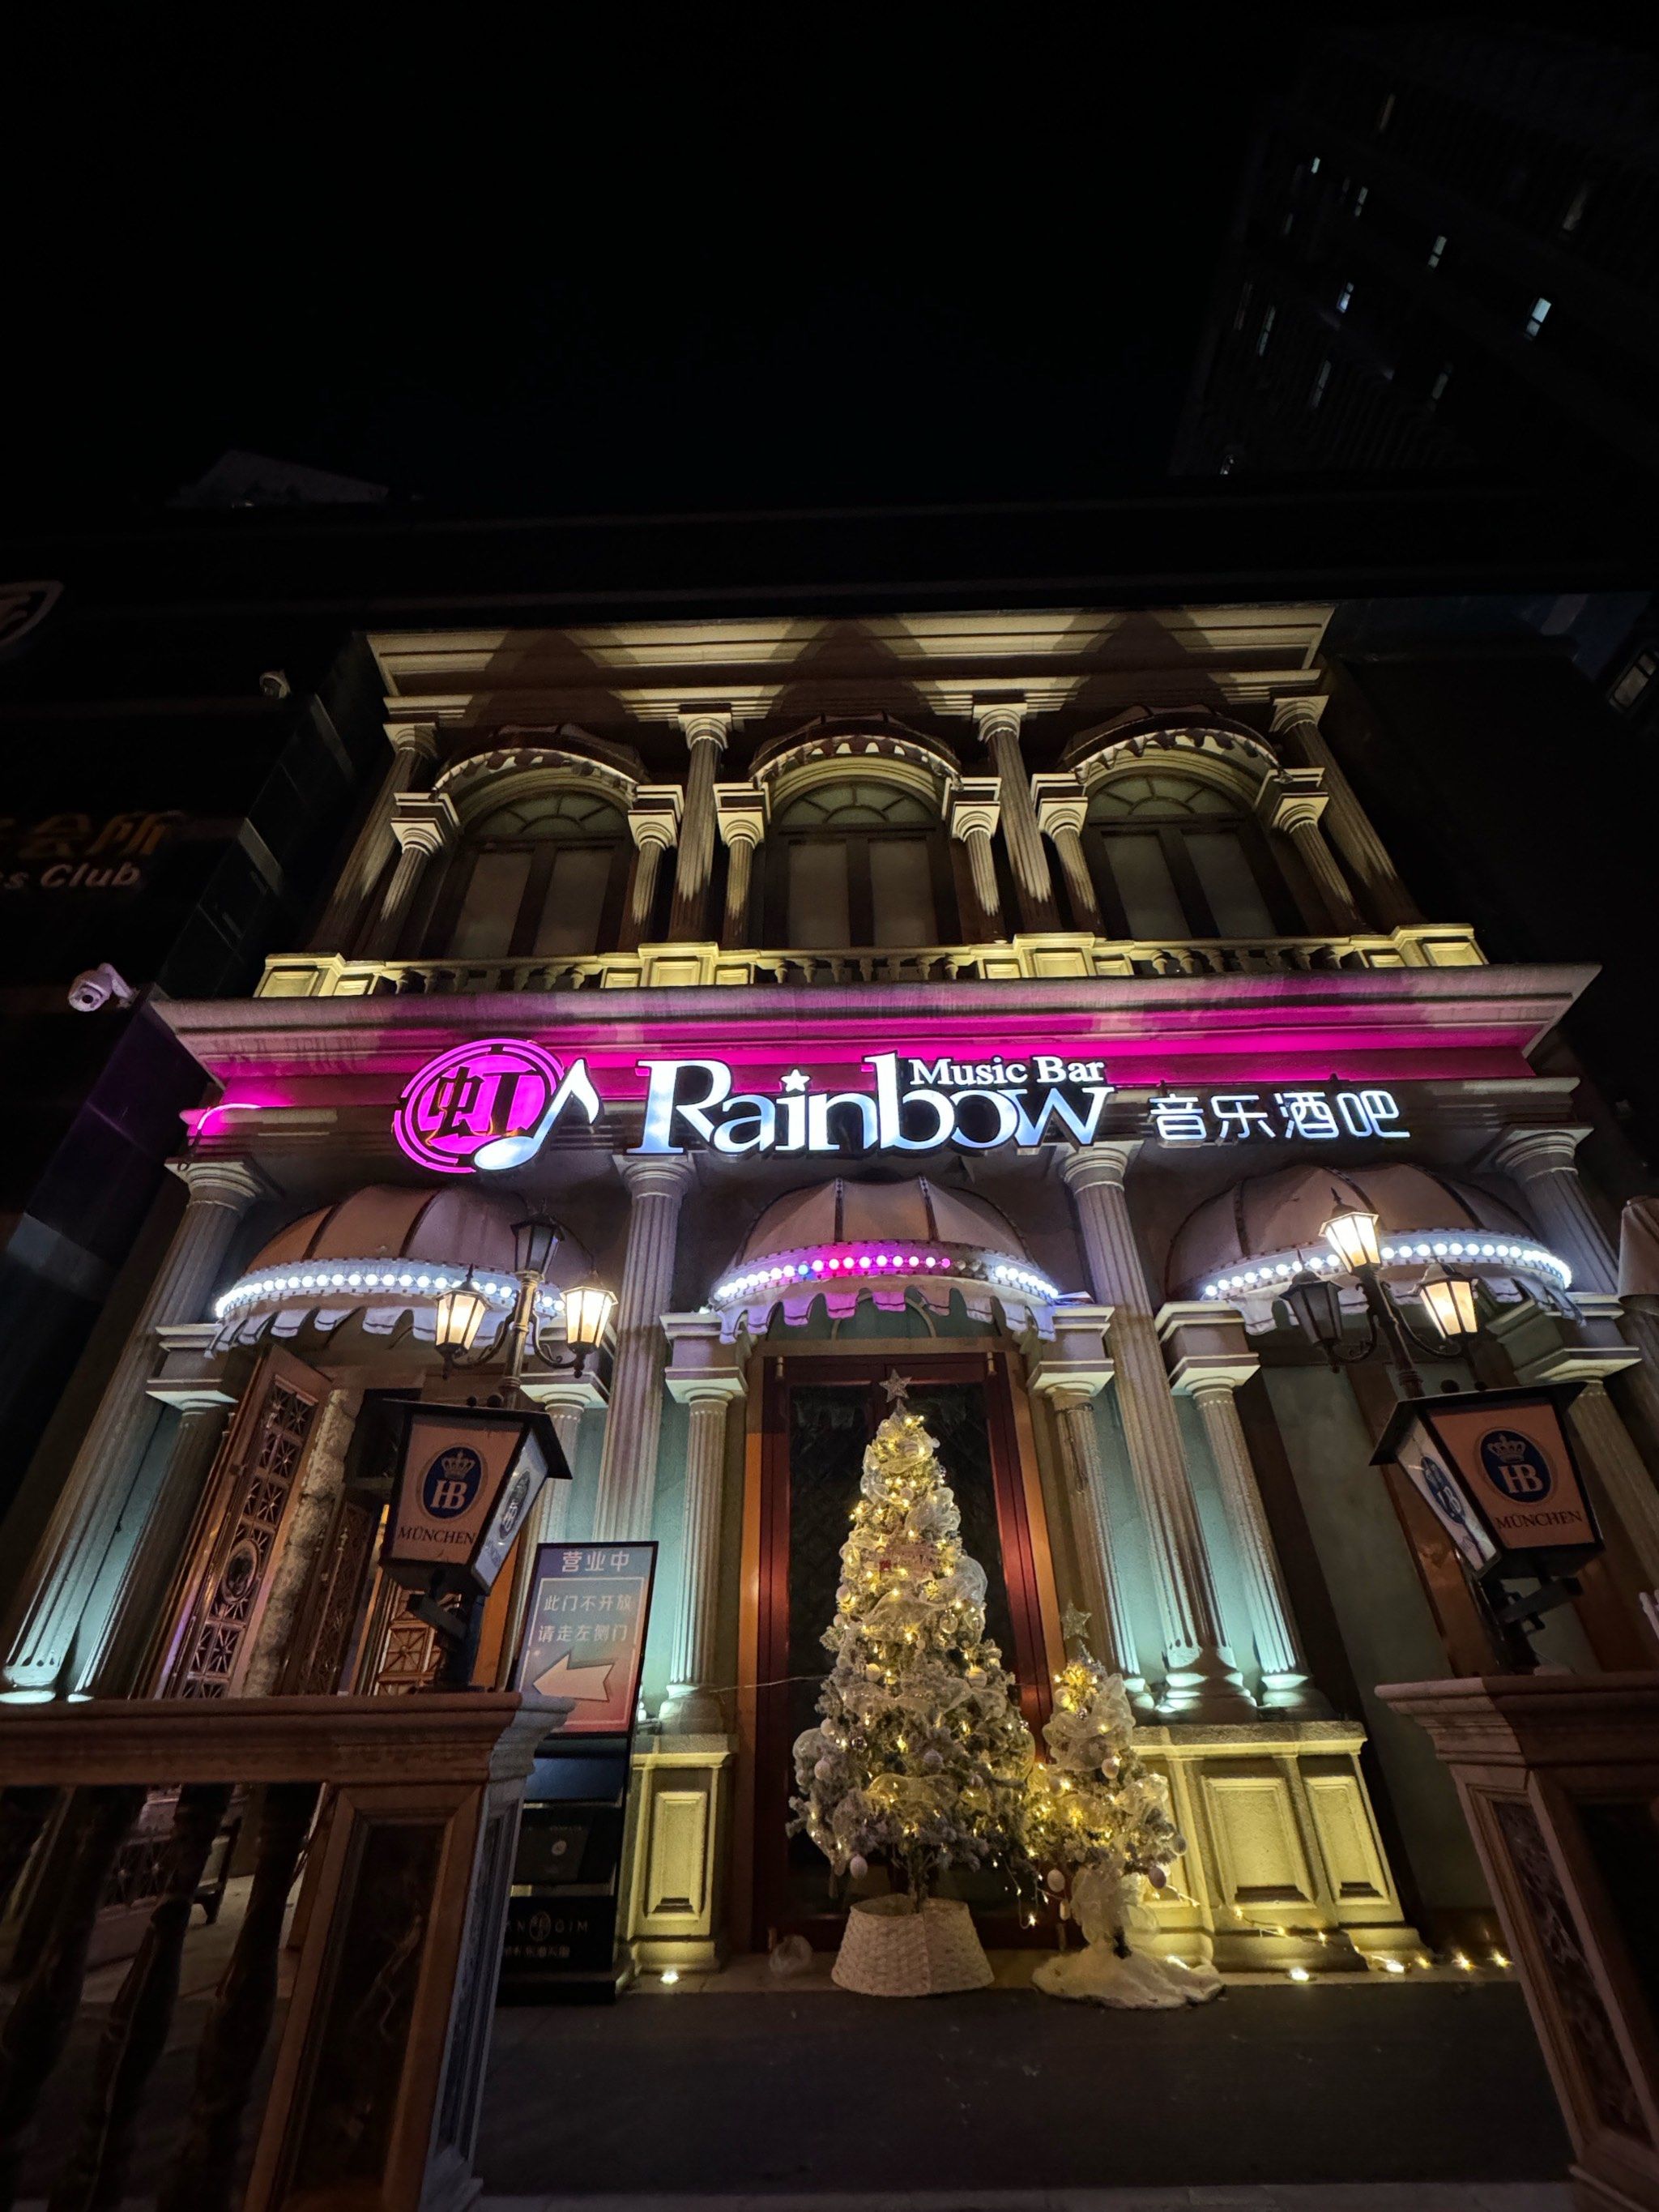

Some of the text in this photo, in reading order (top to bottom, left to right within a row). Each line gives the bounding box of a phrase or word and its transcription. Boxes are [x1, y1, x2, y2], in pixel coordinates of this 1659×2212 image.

[0, 810, 184, 861] 会所
[40, 861, 142, 889] Club
[910, 1055, 1107, 1086] Music Bar
[625, 1052, 1114, 1153] Rainbow
[1149, 1090, 1410, 1140] 音乐酒吧
[1498, 1463, 1543, 1494] HB
[430, 1479, 468, 1510] HB
[398, 1526, 477, 1544] MÜNCHEN
[562, 1551, 629, 1572] 营业中
[543, 1594, 633, 1612] 此门不开放
[538, 1624, 628, 1642] 请走左侧门
